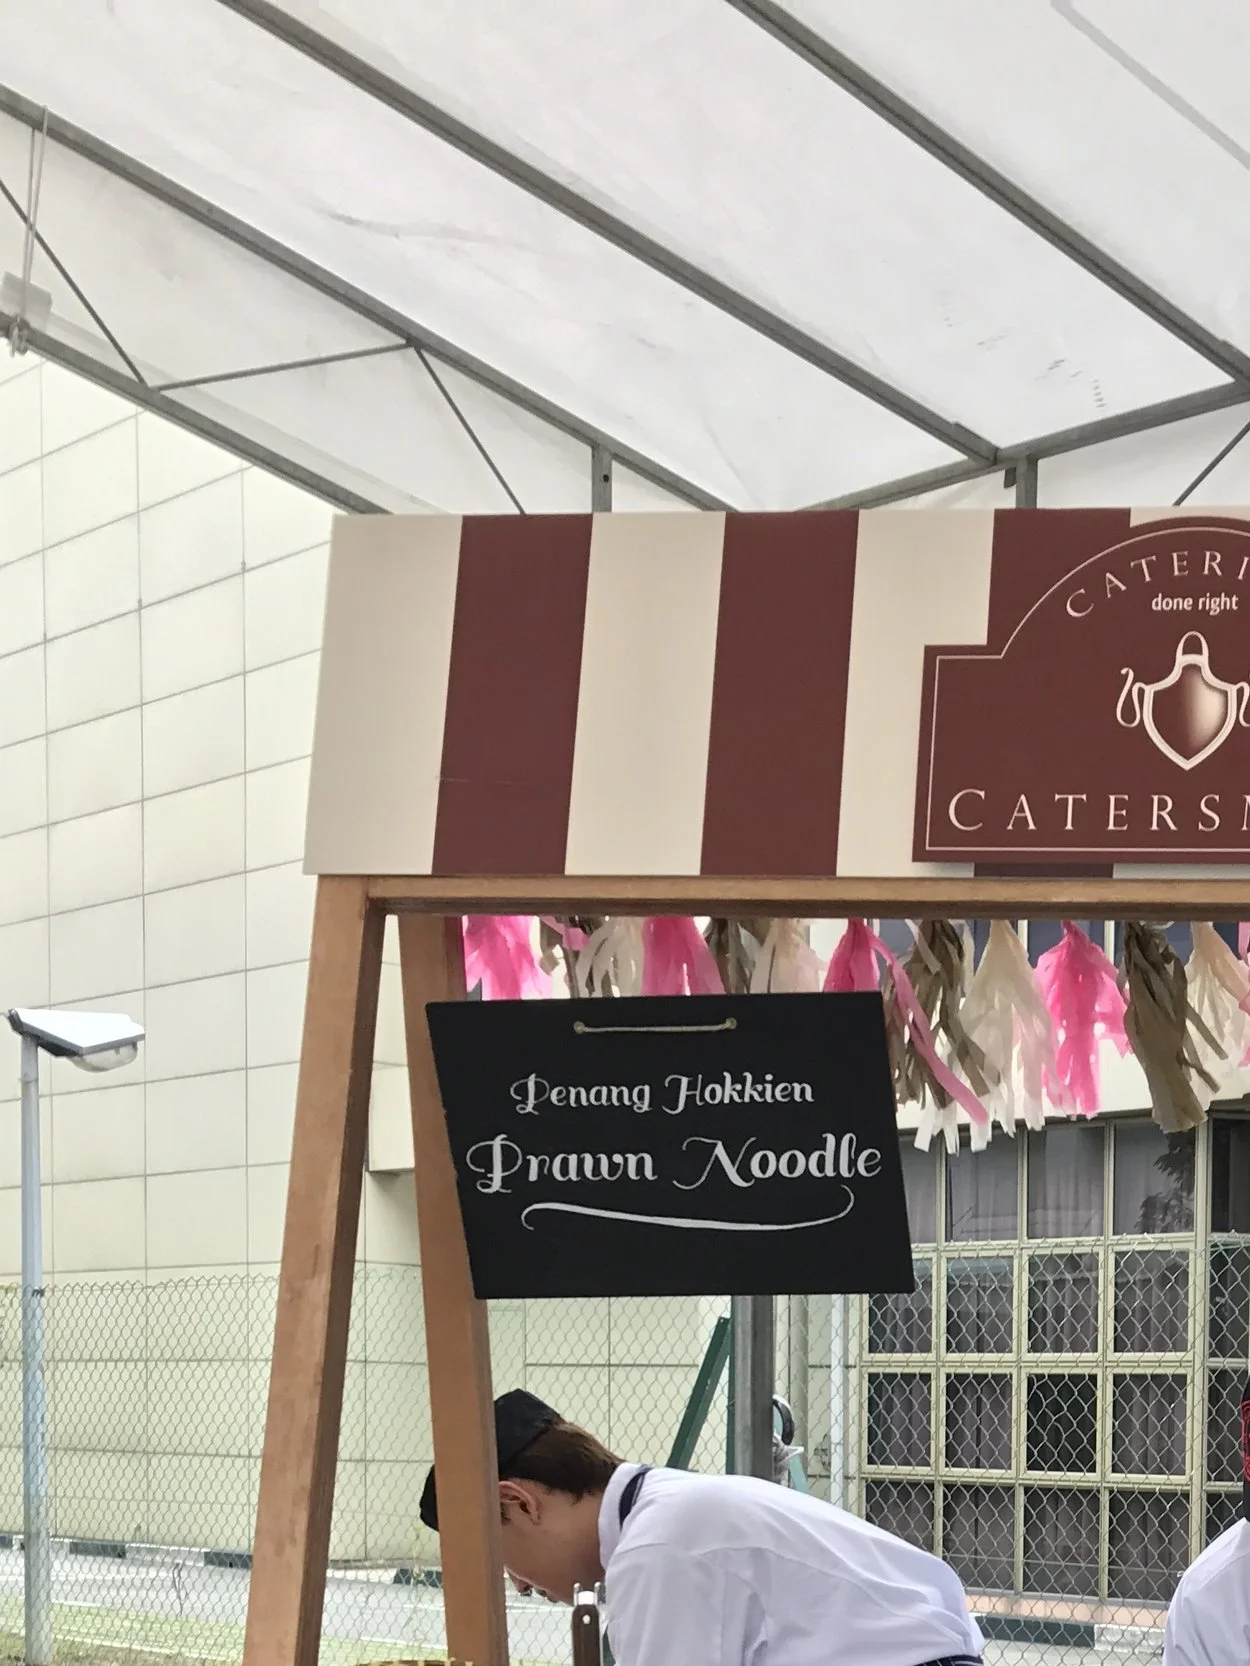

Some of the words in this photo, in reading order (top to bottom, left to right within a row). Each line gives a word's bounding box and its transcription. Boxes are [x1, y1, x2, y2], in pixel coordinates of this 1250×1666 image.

[1151, 592, 1193, 612] done
[1198, 592, 1239, 616] right
[509, 1072, 653, 1115] Penang
[661, 1071, 815, 1115] Hokkien
[465, 1133, 658, 1195] Prawn
[672, 1132, 882, 1191] Noodle
